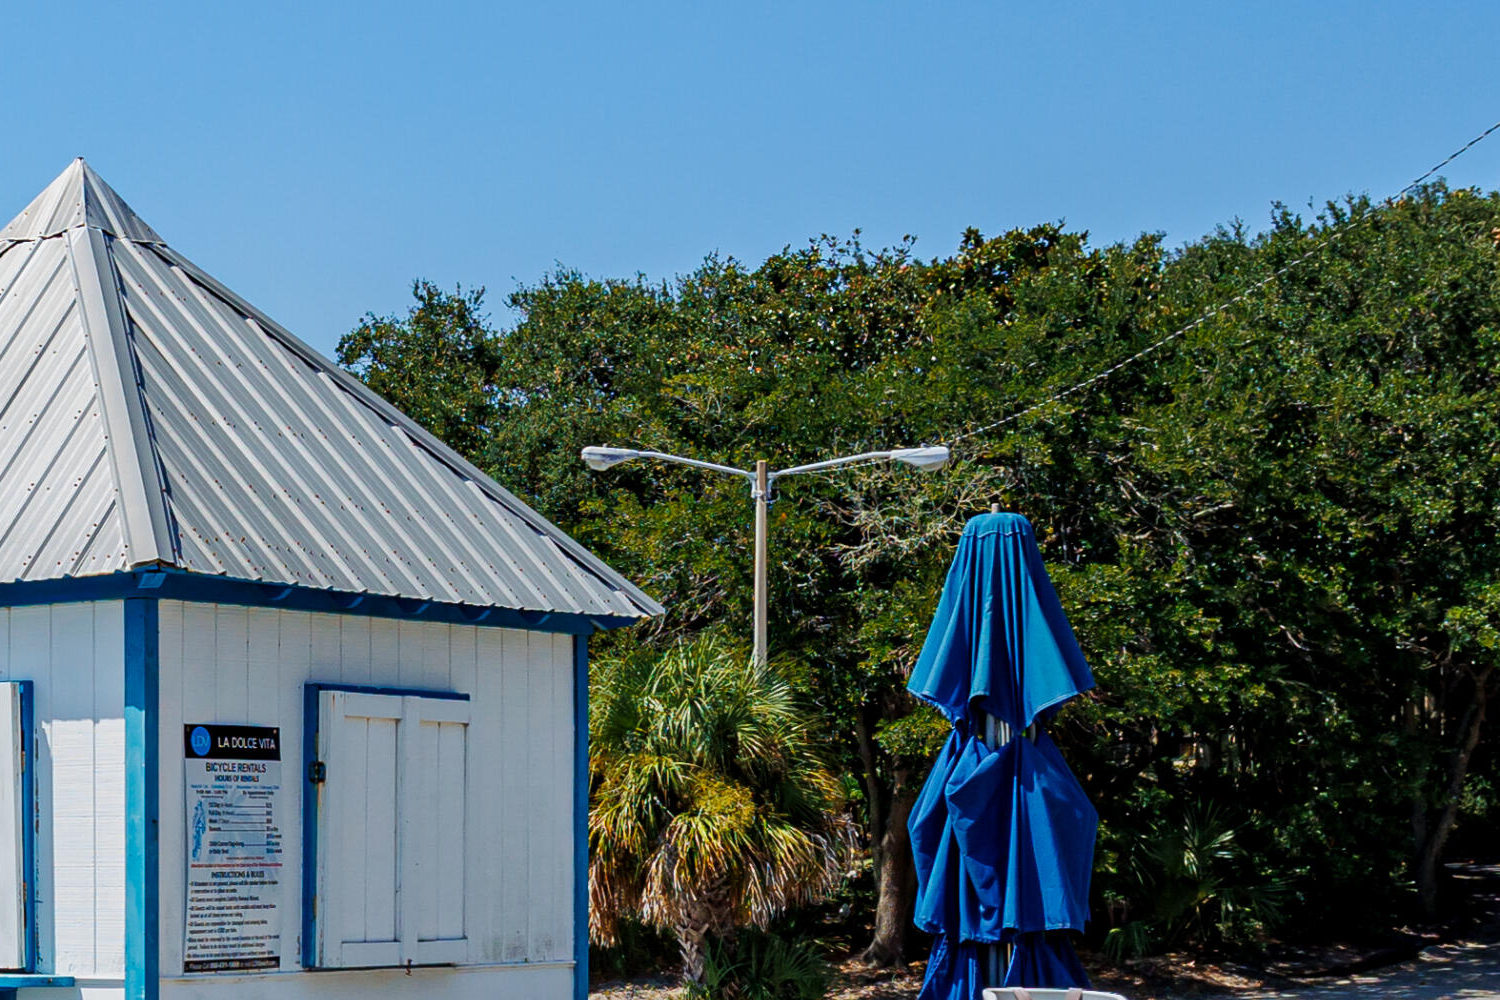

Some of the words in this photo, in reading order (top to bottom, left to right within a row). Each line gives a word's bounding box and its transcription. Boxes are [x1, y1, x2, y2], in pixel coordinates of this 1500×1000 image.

[217, 736, 229, 748] LA
[231, 736, 258, 749] DOLCE
[258, 738, 276, 750] VITA
[205, 762, 237, 773] BICYCLE
[238, 763, 267, 773] RENTALS
[240, 775, 260, 783] RENTALS
[211, 871, 245, 879] INSTRUCTIONS
